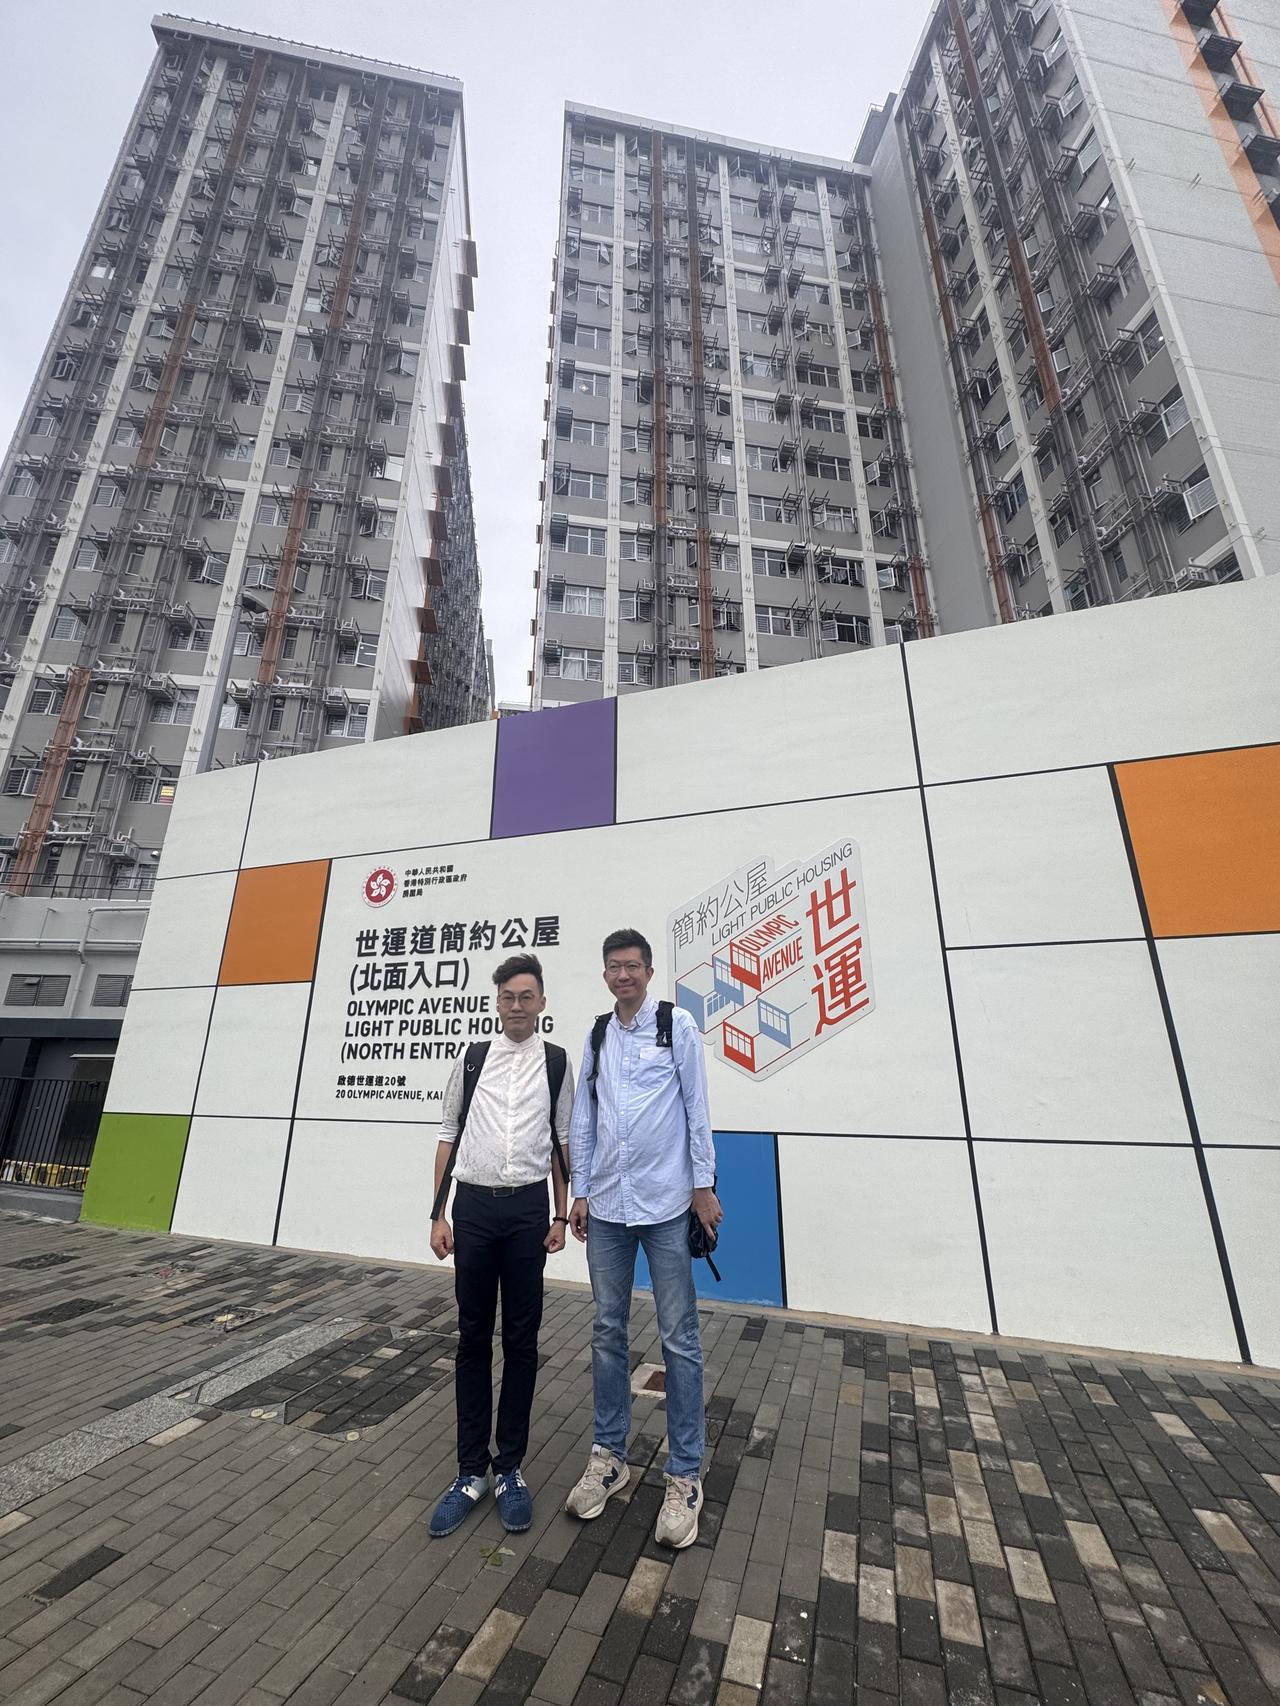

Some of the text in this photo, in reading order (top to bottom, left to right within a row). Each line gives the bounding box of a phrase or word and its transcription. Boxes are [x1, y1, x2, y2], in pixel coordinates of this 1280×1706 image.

[672, 861, 768, 949] 簡約公屋
[711, 842, 853, 946] LIGHT PUBLIC HOUSING
[355, 915, 560, 958] 世運道簡約公屋
[738, 914, 800, 951] OLYMPIC
[805, 867, 871, 1037] 世運
[350, 957, 470, 996] (北面入口)
[762, 936, 804, 985] AVENUE
[346, 995, 490, 1017] OLYMPIC AVENUE
[344, 1018, 395, 1038] LIGHT
[398, 1017, 462, 1037] PUBLIC
[340, 1042, 406, 1064] (NORTH
[335, 1089, 443, 1102] 20 OLYMPIC AVENUE, KAI
